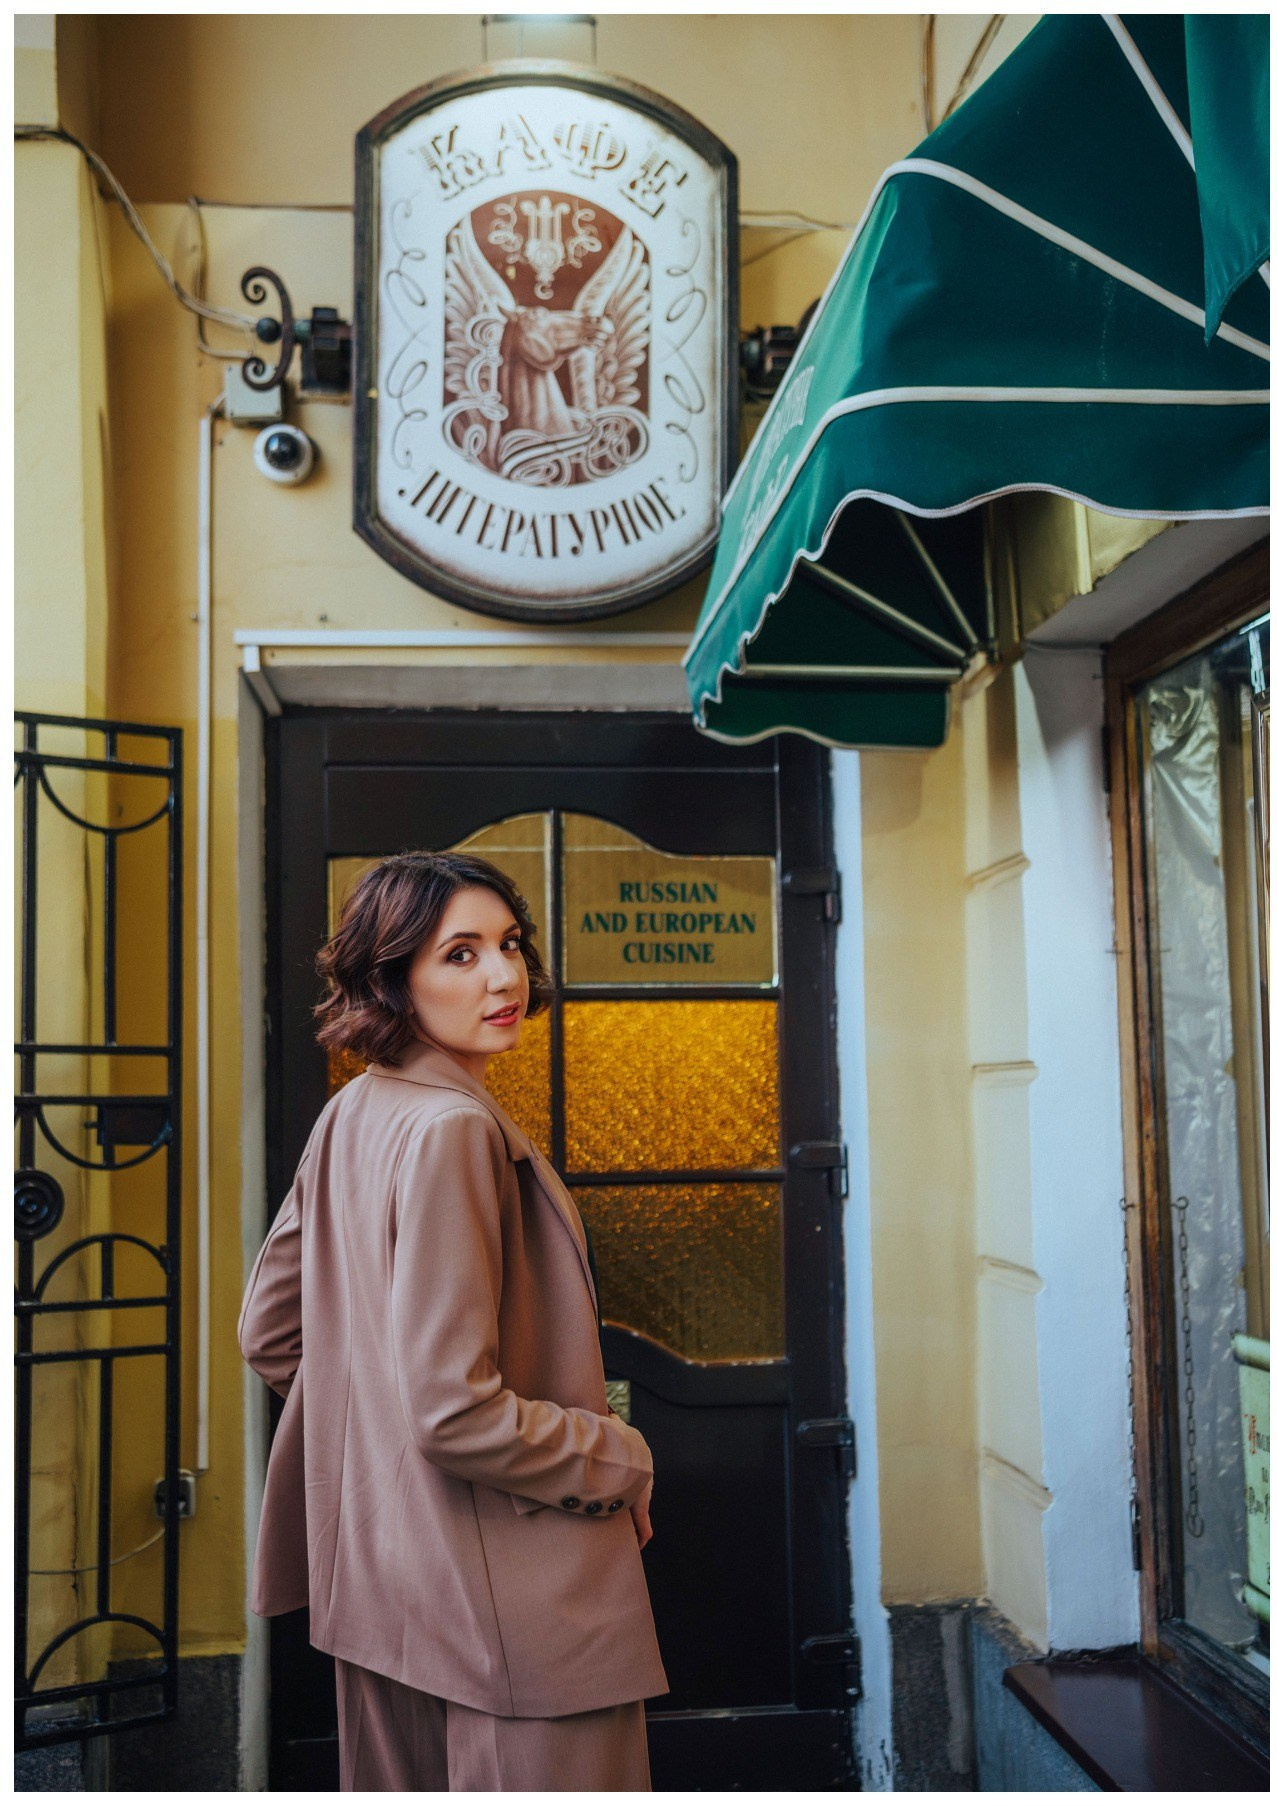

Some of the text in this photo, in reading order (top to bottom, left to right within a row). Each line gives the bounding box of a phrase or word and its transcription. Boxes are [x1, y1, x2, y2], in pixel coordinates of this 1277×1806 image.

[412, 114, 689, 220] КАФЕ
[398, 468, 687, 559] ЛИТЕРАТУРНОЕ
[619, 882, 718, 903] RUSSIAN
[580, 912, 756, 934] AND EUROPEAN
[622, 942, 716, 964] CUISINE
